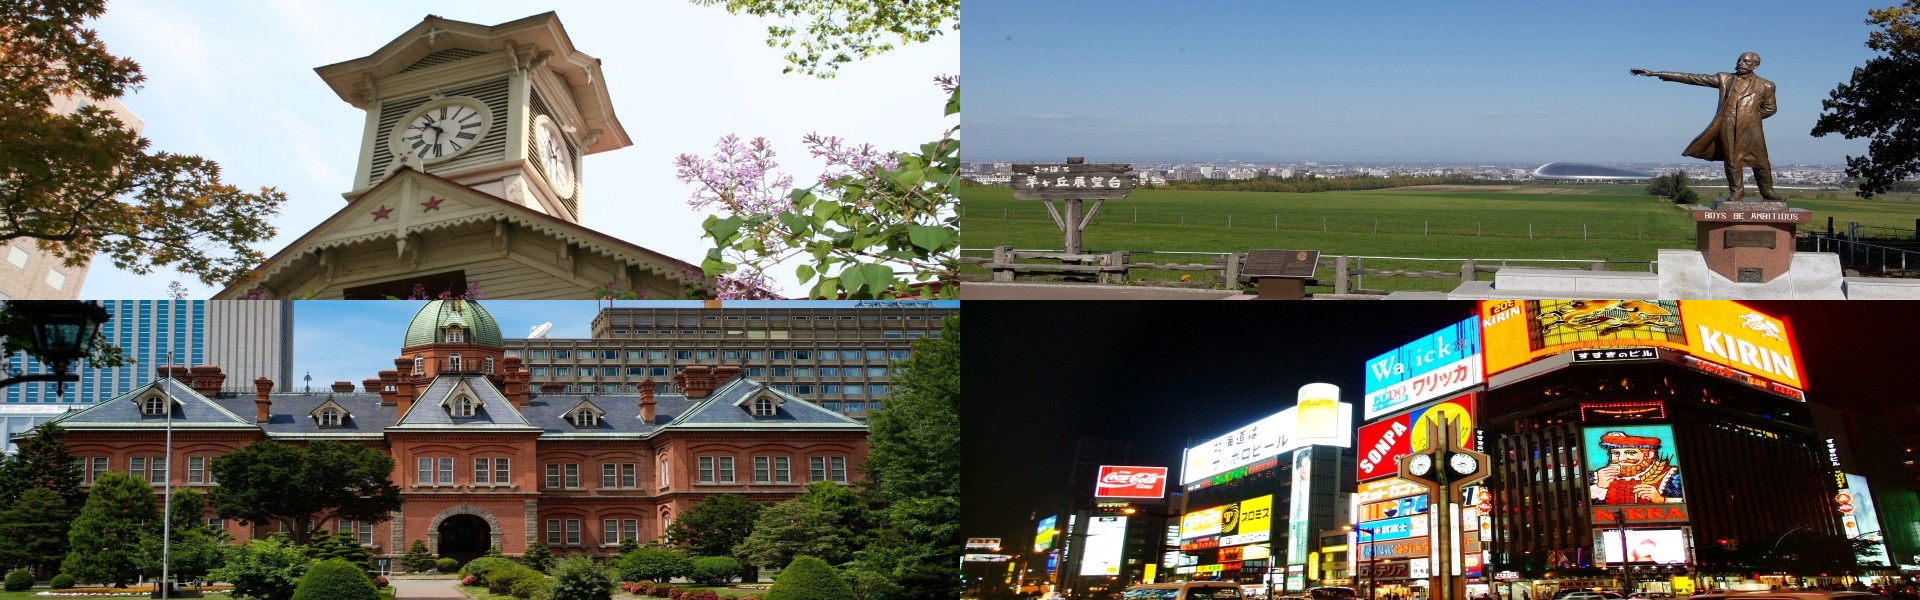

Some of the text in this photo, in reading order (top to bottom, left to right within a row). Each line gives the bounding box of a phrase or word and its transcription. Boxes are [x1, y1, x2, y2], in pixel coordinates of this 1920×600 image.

[1704, 211, 1799, 221] BOYS BE AMBITIOUS
[1483, 306, 1521, 328] KIRIN
[1577, 350, 1653, 360] すすきのビル
[1697, 324, 1795, 381] KIRIN
[1412, 365, 1468, 397] ワリッカ
[1359, 420, 1408, 474] SONPA
[1103, 471, 1159, 485] Coca-Cola
[1241, 508, 1270, 522] プロミス
[1593, 507, 1687, 522] NKKA
